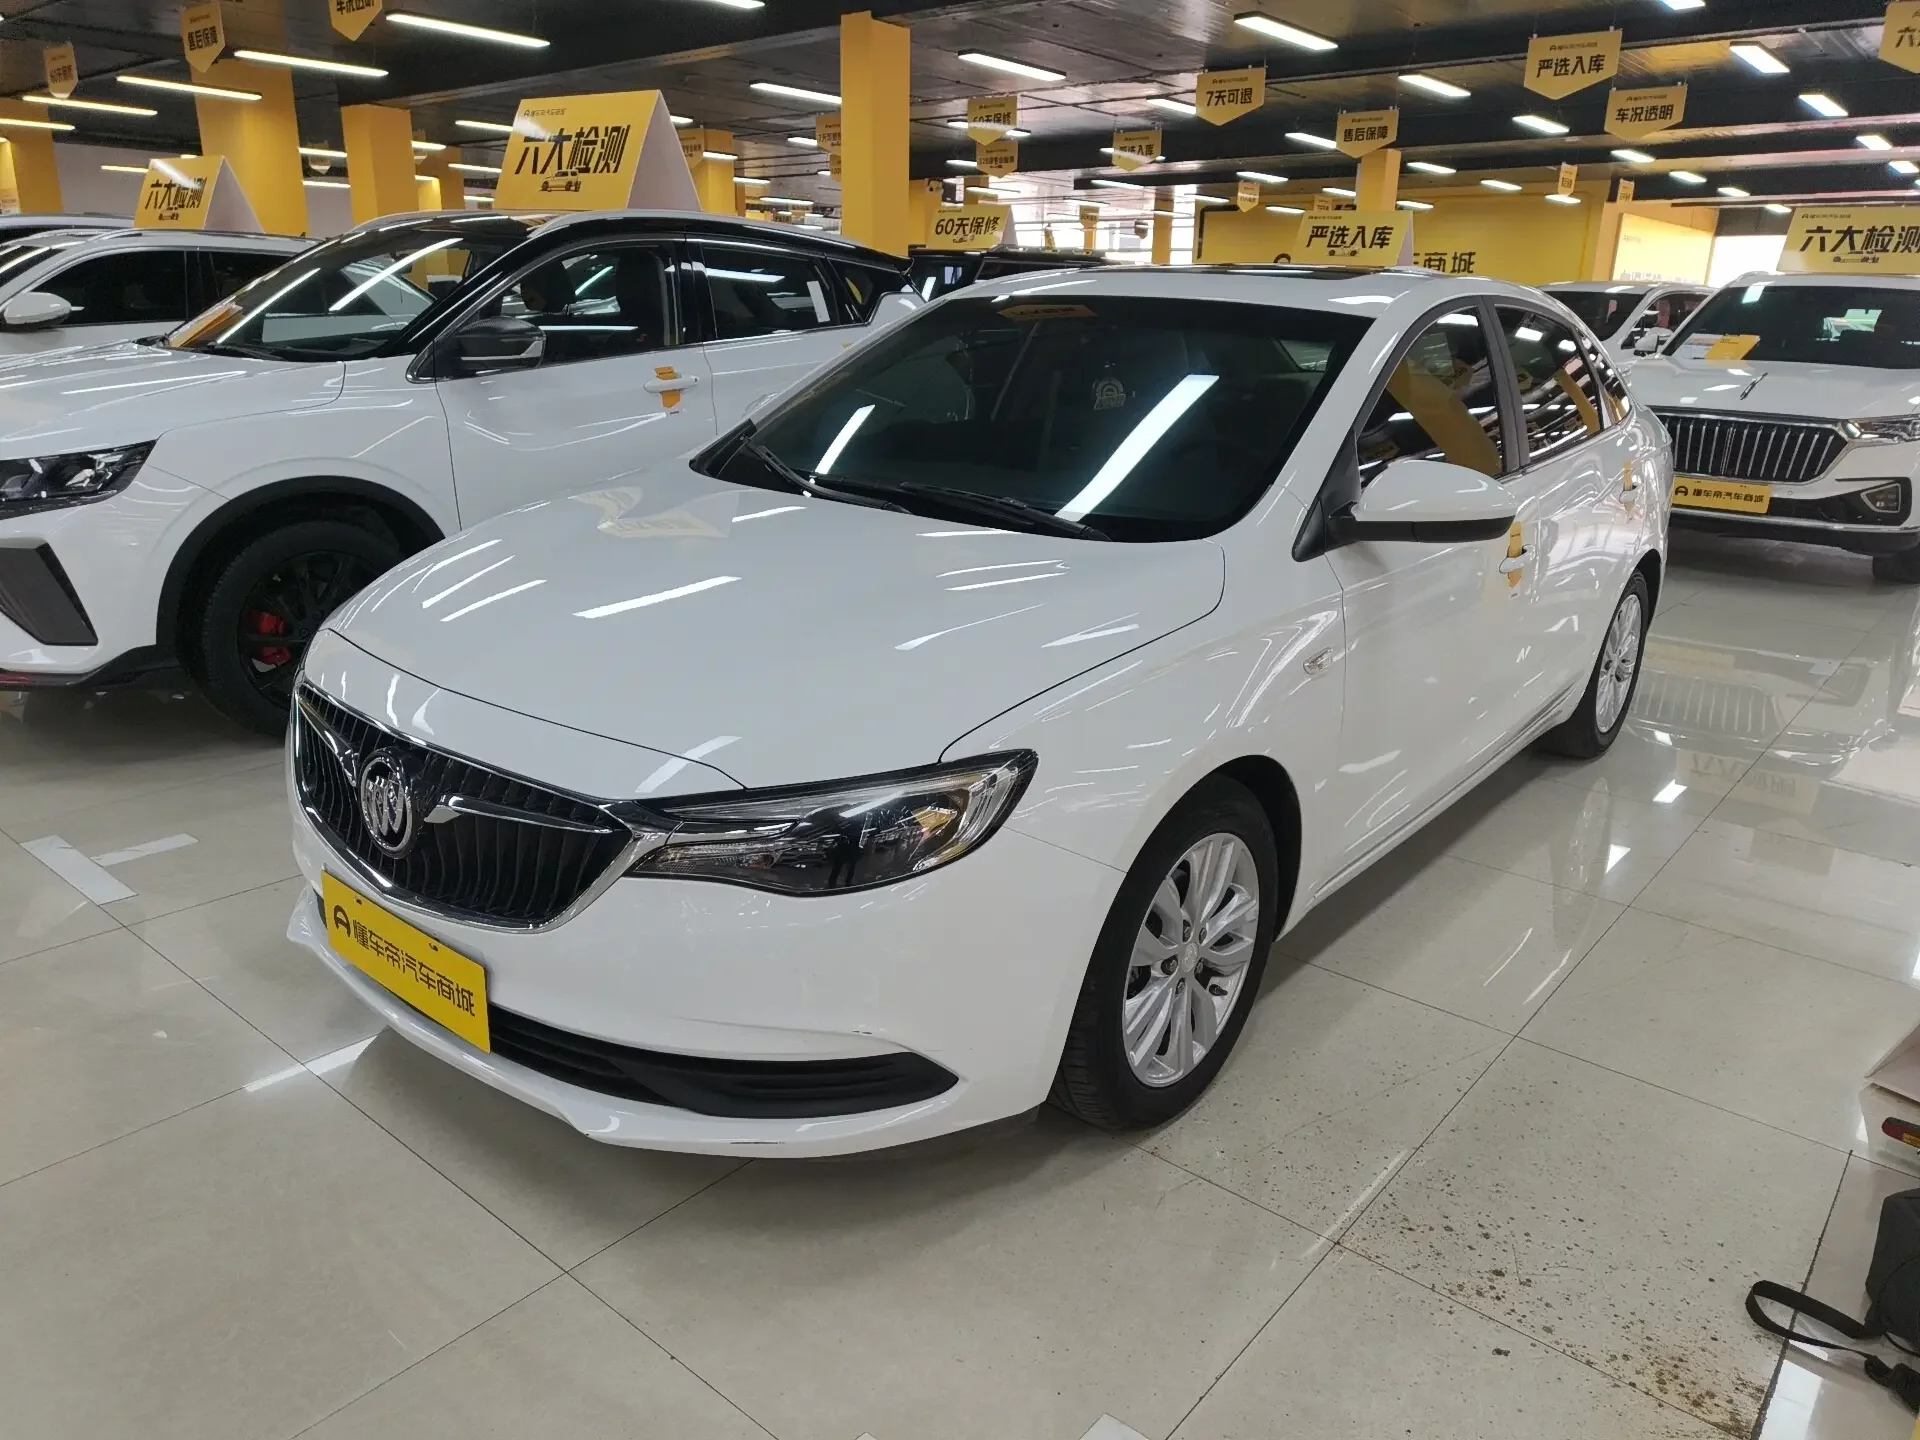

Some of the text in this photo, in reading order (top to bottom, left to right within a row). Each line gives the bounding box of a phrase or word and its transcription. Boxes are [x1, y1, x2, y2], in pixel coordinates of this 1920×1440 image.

[1895, 26, 1920, 48] 六
[1536, 53, 1606, 78] 严选入库
[1206, 87, 1253, 107] 7天可退
[1615, 104, 1674, 123] 车况透明
[1343, 125, 1389, 142] 售后保障
[514, 123, 632, 175] 六大检测
[144, 176, 208, 210] 六大检测
[935, 216, 1001, 236] 60天保修
[1306, 225, 1394, 249] 严选入库
[1799, 225, 1920, 254] 六大检测
[352, 918, 476, 1018] 懂车帝汽车商城
